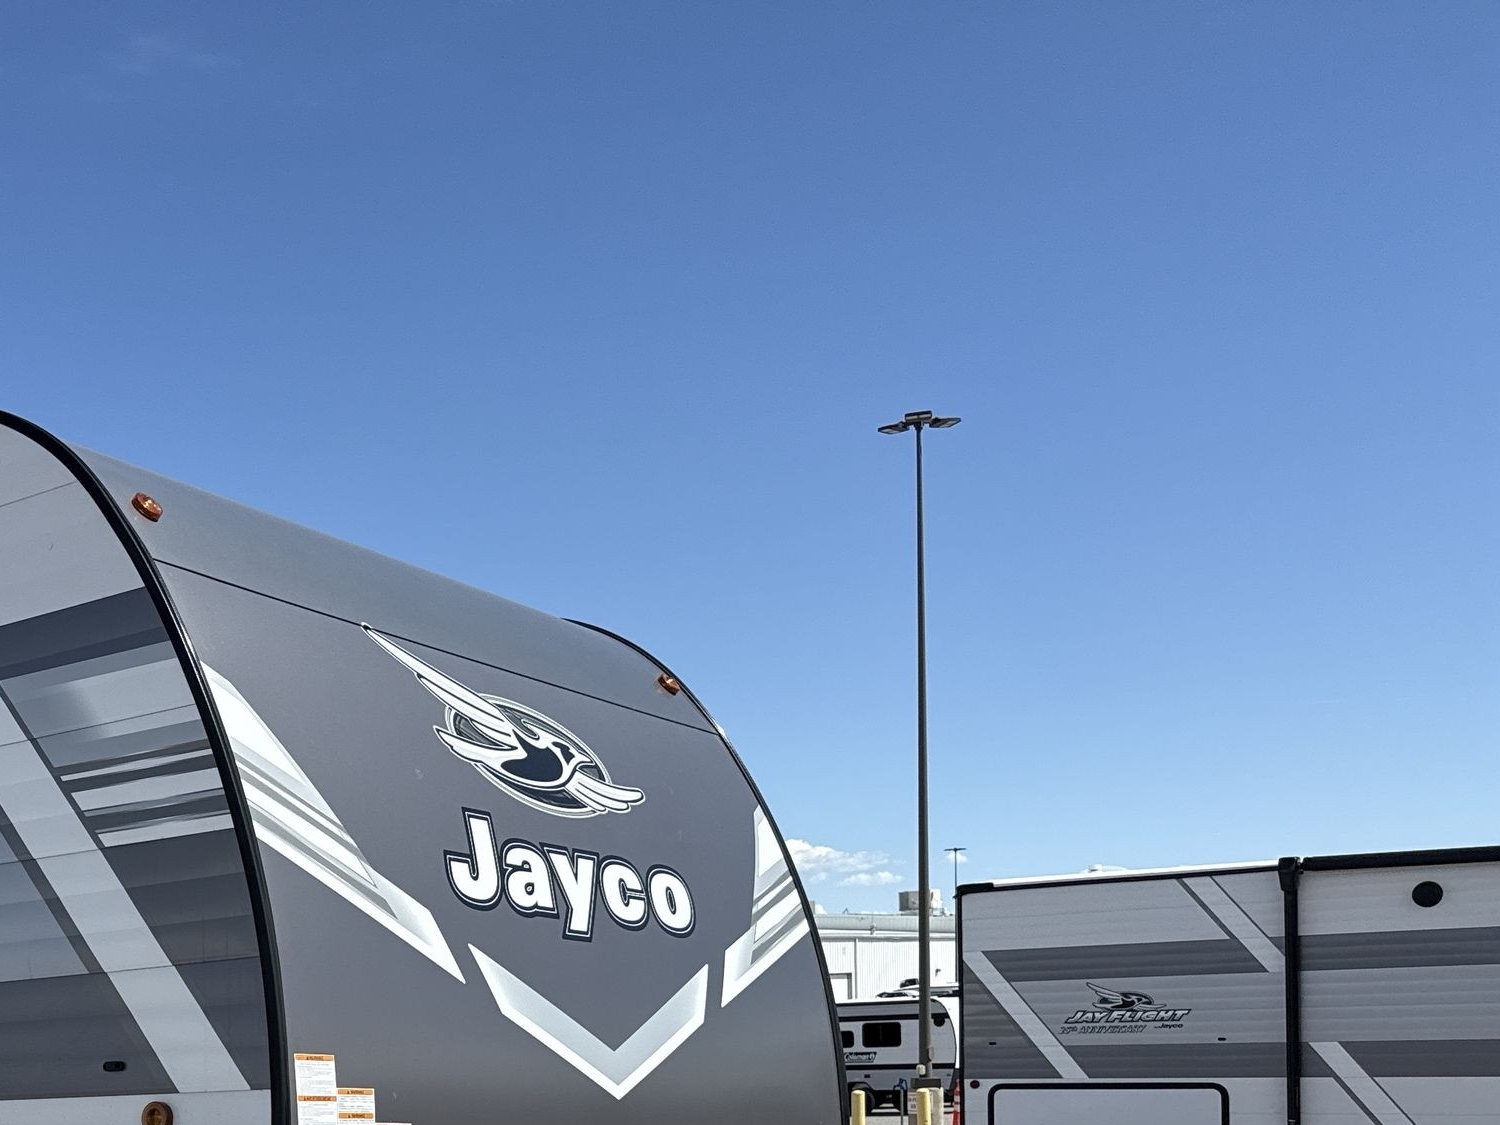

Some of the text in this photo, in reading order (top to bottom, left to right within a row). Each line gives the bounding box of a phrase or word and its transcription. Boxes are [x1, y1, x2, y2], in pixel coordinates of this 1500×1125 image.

[443, 806, 697, 943] Jayco
[1064, 1008, 1192, 1025] JAY FLIGHT
[1159, 1022, 1184, 1030] Jayco
